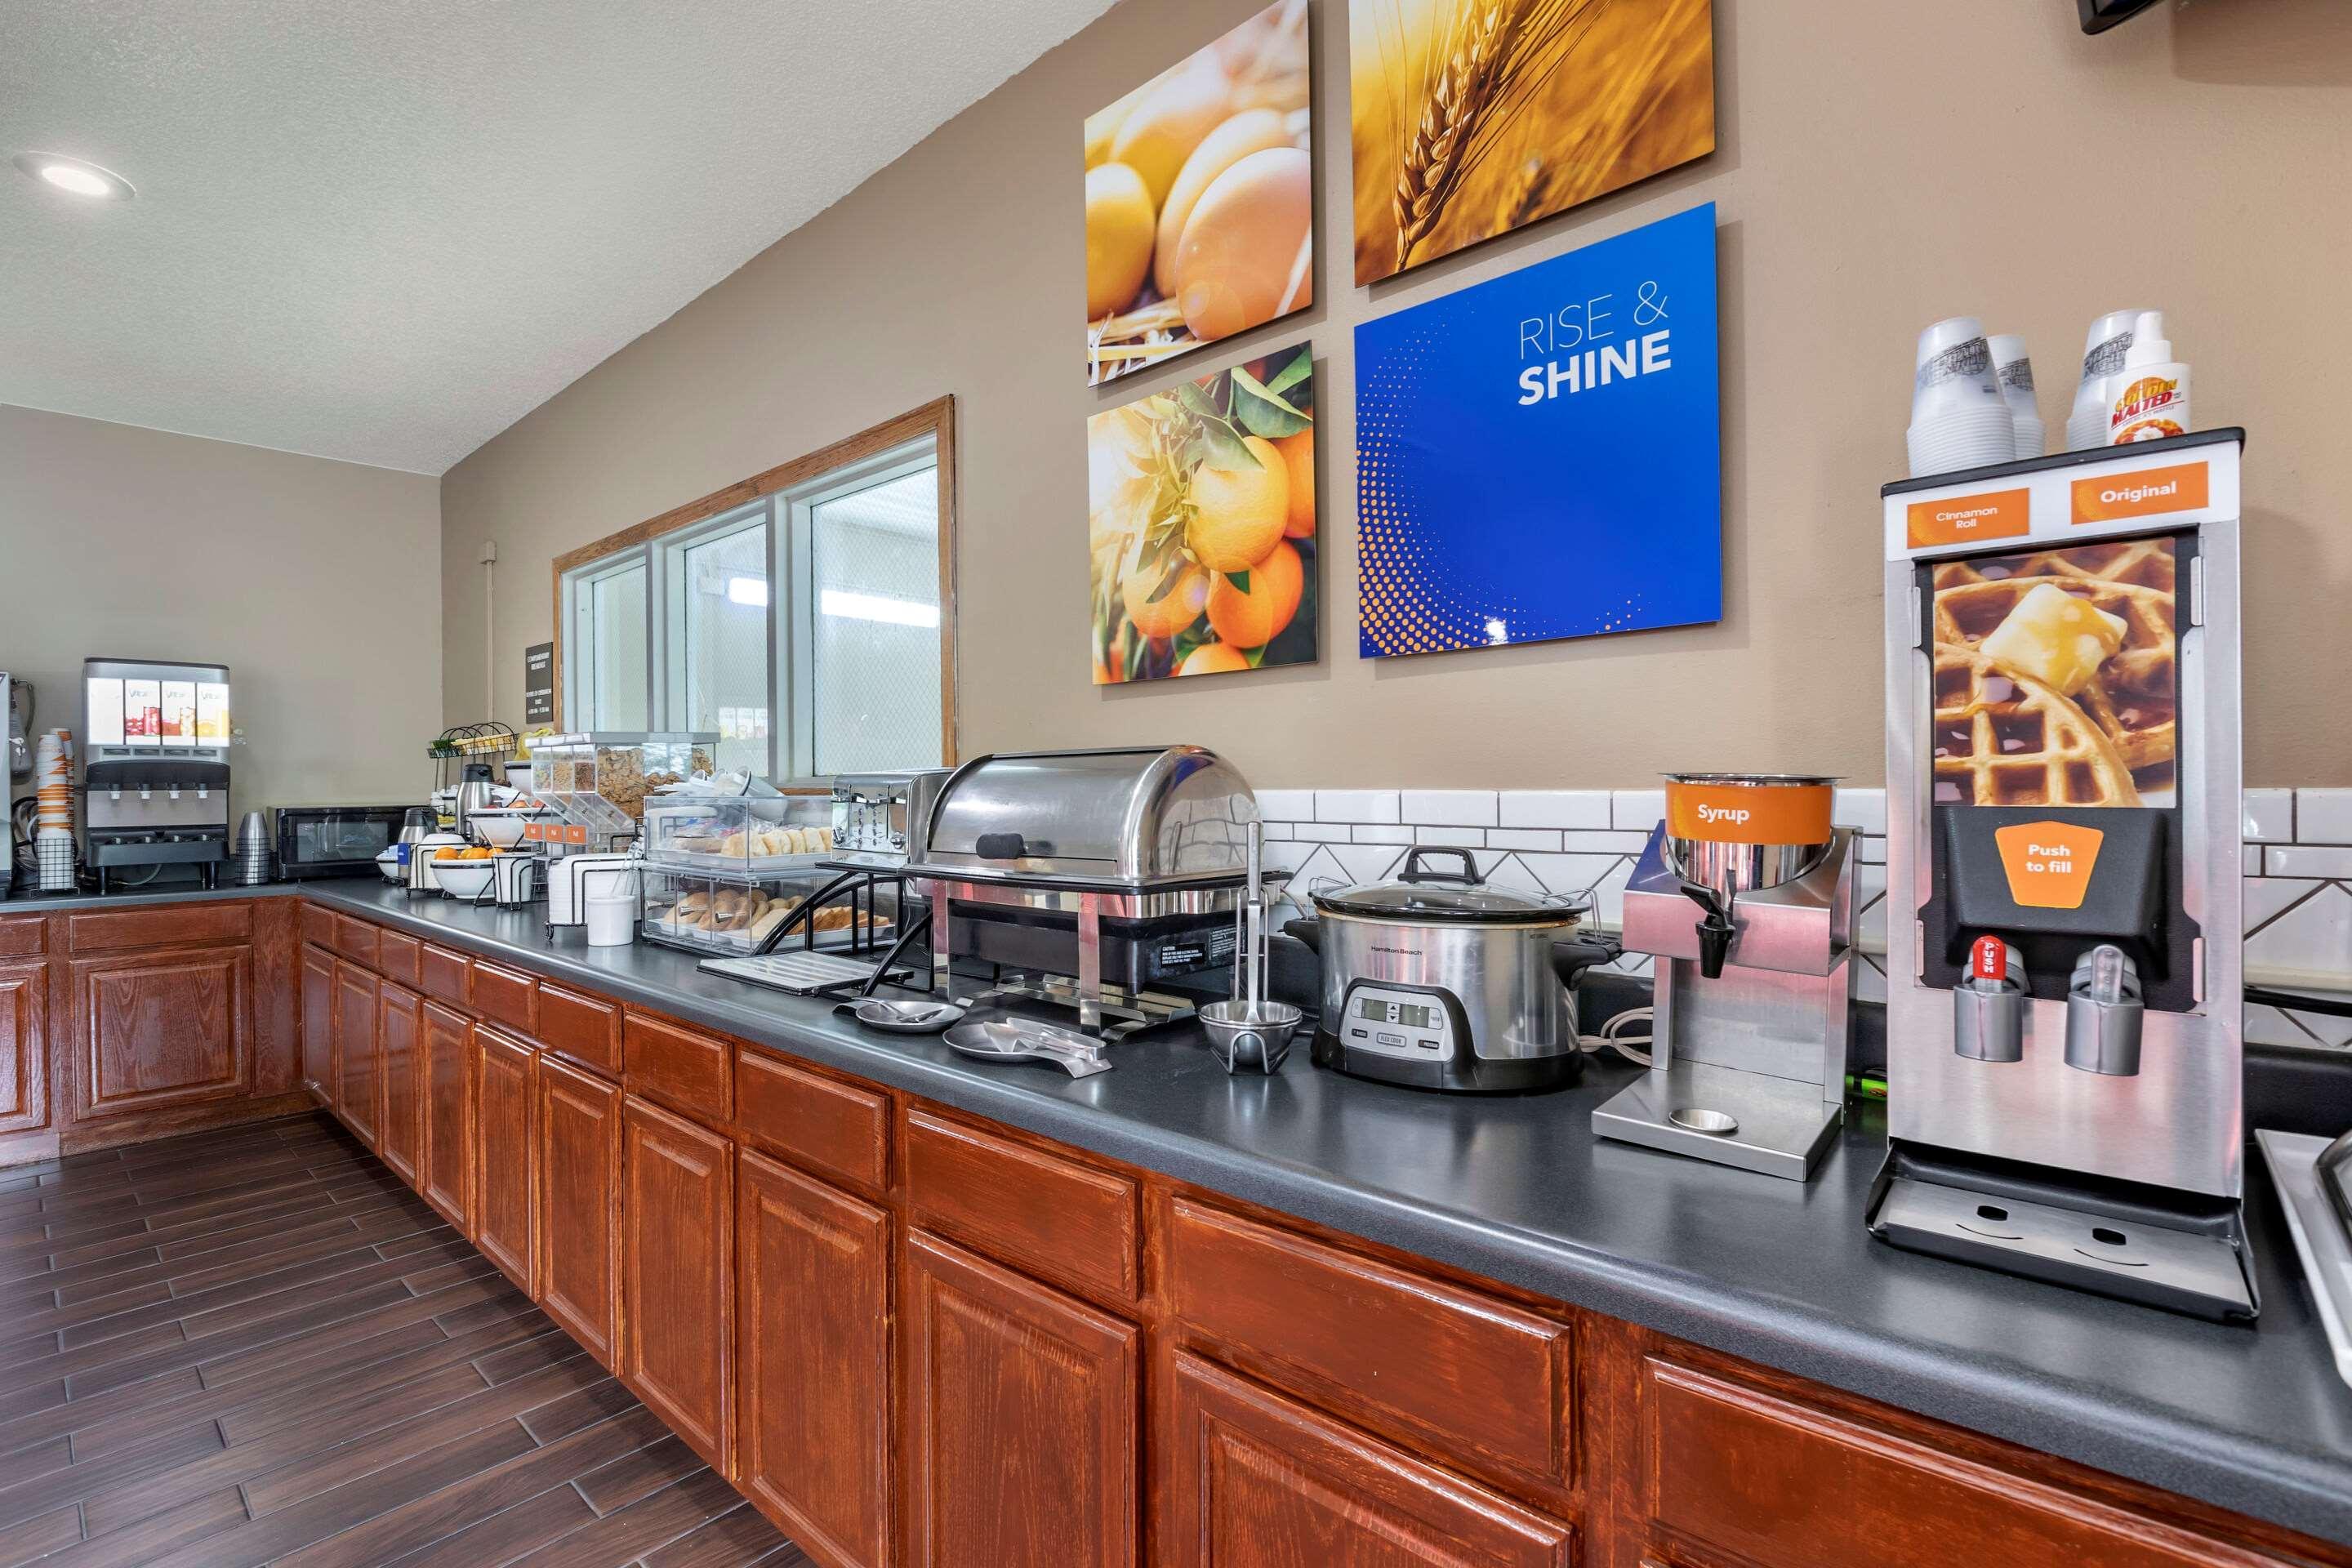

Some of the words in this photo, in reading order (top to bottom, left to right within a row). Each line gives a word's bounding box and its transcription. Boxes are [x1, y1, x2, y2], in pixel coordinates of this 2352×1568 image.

[1521, 293, 1614, 359] RISE
[1633, 280, 1668, 326] &
[1517, 329, 1672, 406] SHINE
[2111, 391, 2173, 427] MALTED
[2100, 481, 2177, 505] Original
[1936, 506, 1998, 522] Cinnamon
[1956, 519, 1977, 529] Roll
[1698, 804, 1750, 825] Syrup
[2028, 844, 2071, 856] Push
[2025, 862, 2045, 872] to
[2048, 861, 2072, 873] fill
[1371, 946, 1399, 954] Hamilton
[1984, 942, 1995, 973] PUSH
